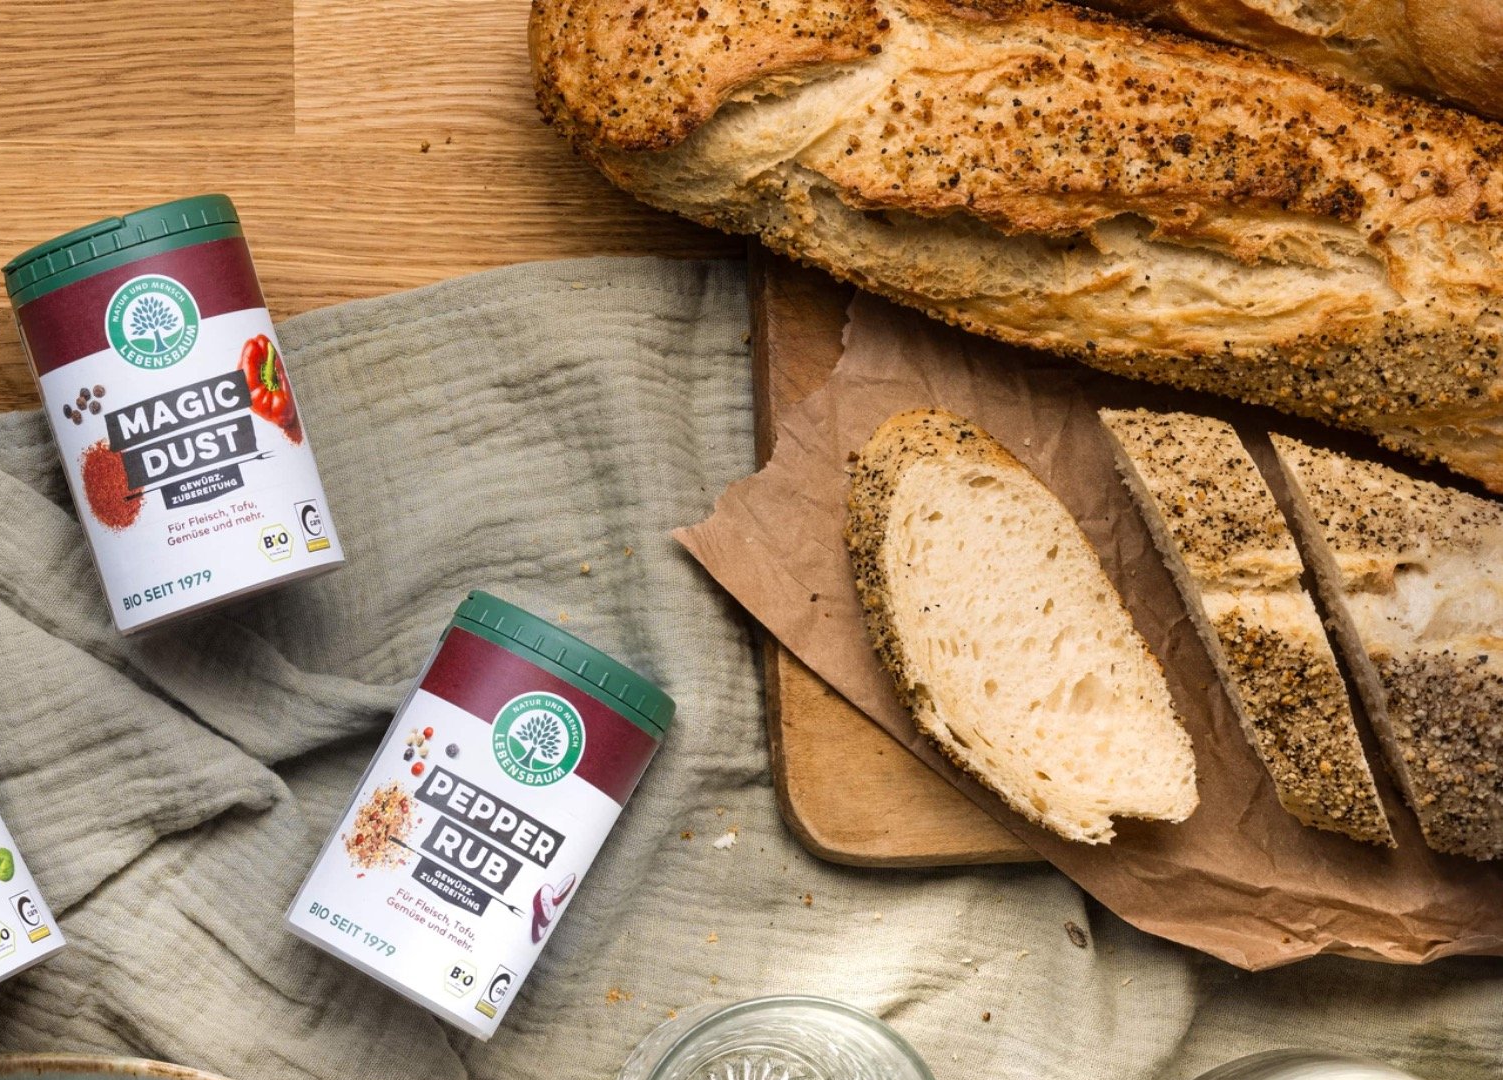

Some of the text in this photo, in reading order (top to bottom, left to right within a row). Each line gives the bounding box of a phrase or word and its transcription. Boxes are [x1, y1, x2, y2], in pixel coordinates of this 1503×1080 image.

[113, 282, 185, 322] NATUR UND MENSCH
[120, 325, 196, 367] LEBENSBAUM
[117, 381, 240, 440] MAGIC
[142, 424, 238, 478] DUST
[172, 479, 237, 504] ZUBEREITUNG
[180, 473, 224, 492] GEWÜRZ-
[167, 512, 264, 546] Gemüse und mehr.
[168, 501, 257, 533] Für Fleisch, Tofu,
[123, 570, 212, 610] BIO SEIT 1979
[513, 699, 579, 747] NATUR UND MENSCH
[495, 733, 565, 784] LEBENSBAUM
[426, 771, 555, 862] PEPPER
[433, 825, 508, 883] RUB
[420, 872, 480, 911] ZUBEREITUNG
[435, 870, 475, 896] GEWÜRZ-
[309, 902, 397, 956] BIO SEIT 1979
[387, 896, 473, 953] Gemüse und mehr.
[397, 888, 475, 941] Für Fleisch, Tofu,
